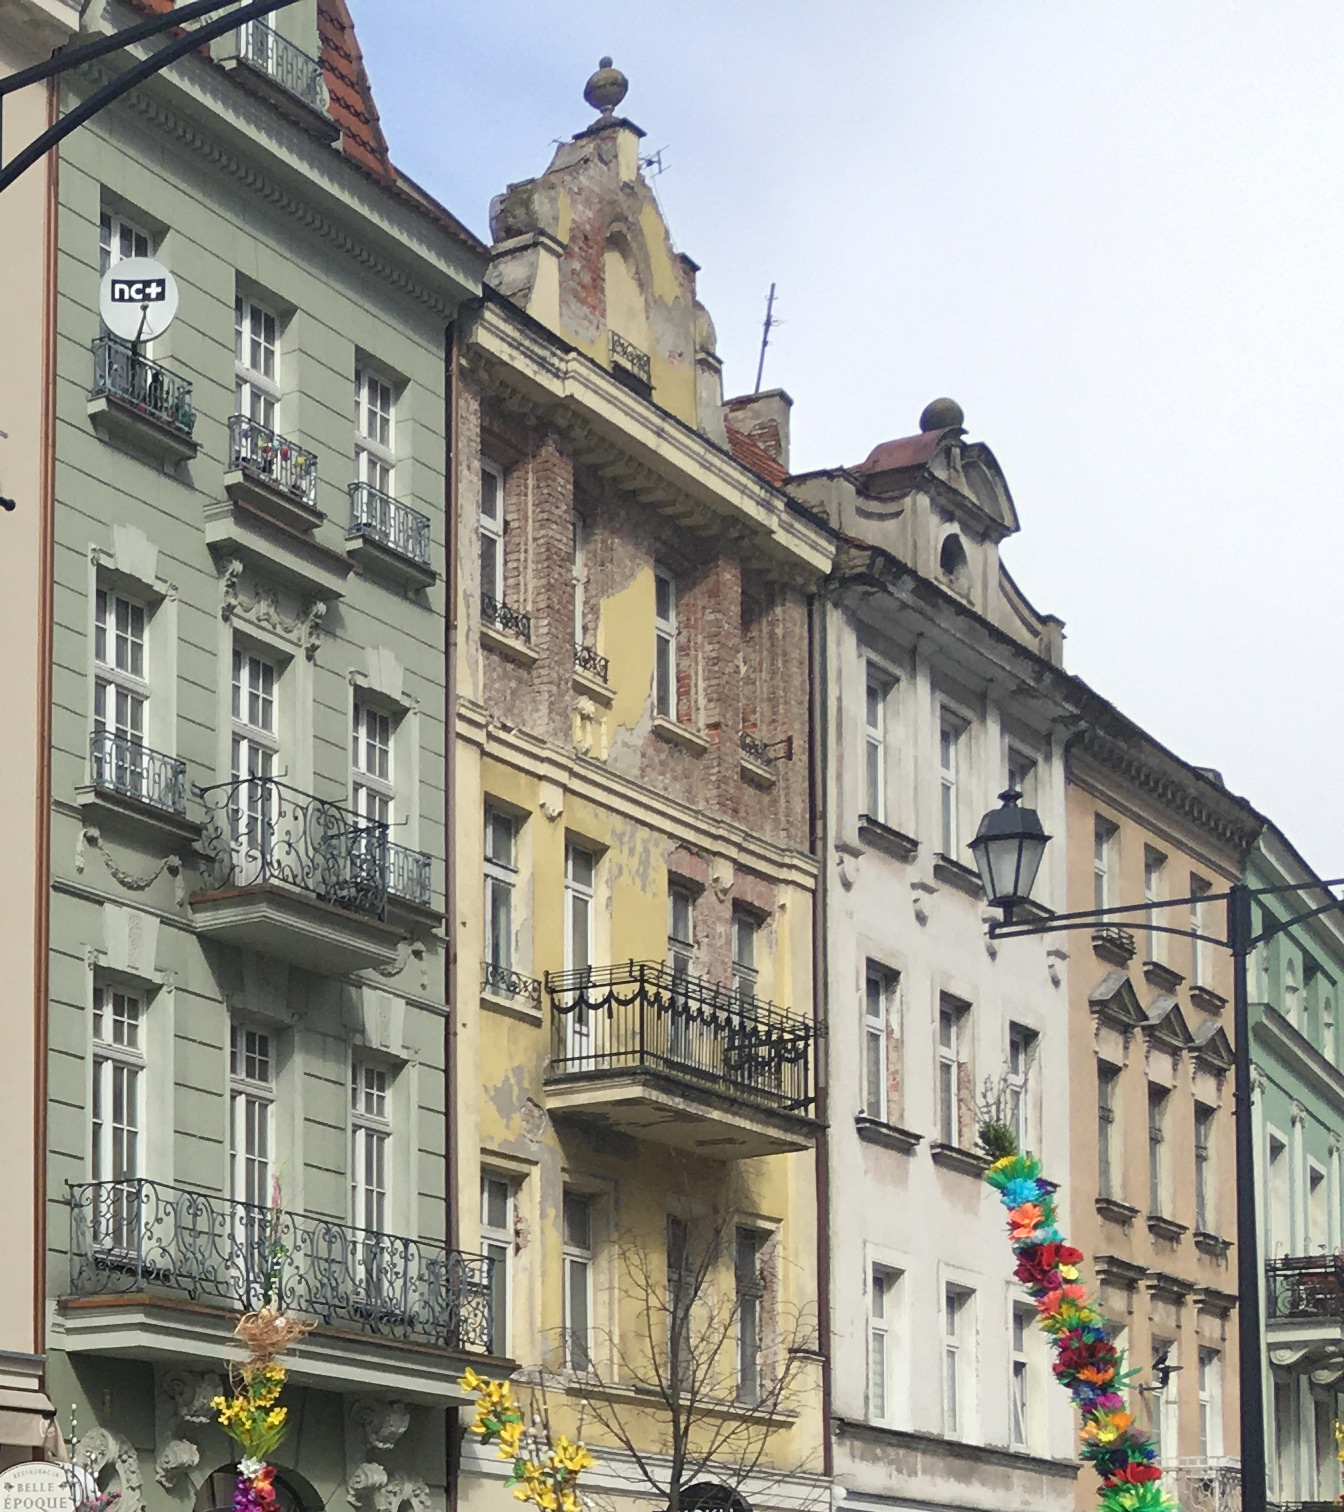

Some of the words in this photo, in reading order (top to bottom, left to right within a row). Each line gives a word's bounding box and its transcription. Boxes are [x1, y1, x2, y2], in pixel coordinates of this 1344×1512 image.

[114, 282, 162, 299] nc+
[17, 1482, 55, 1493] BELLE
[3, 1495, 67, 1512] ÉPOQUE
